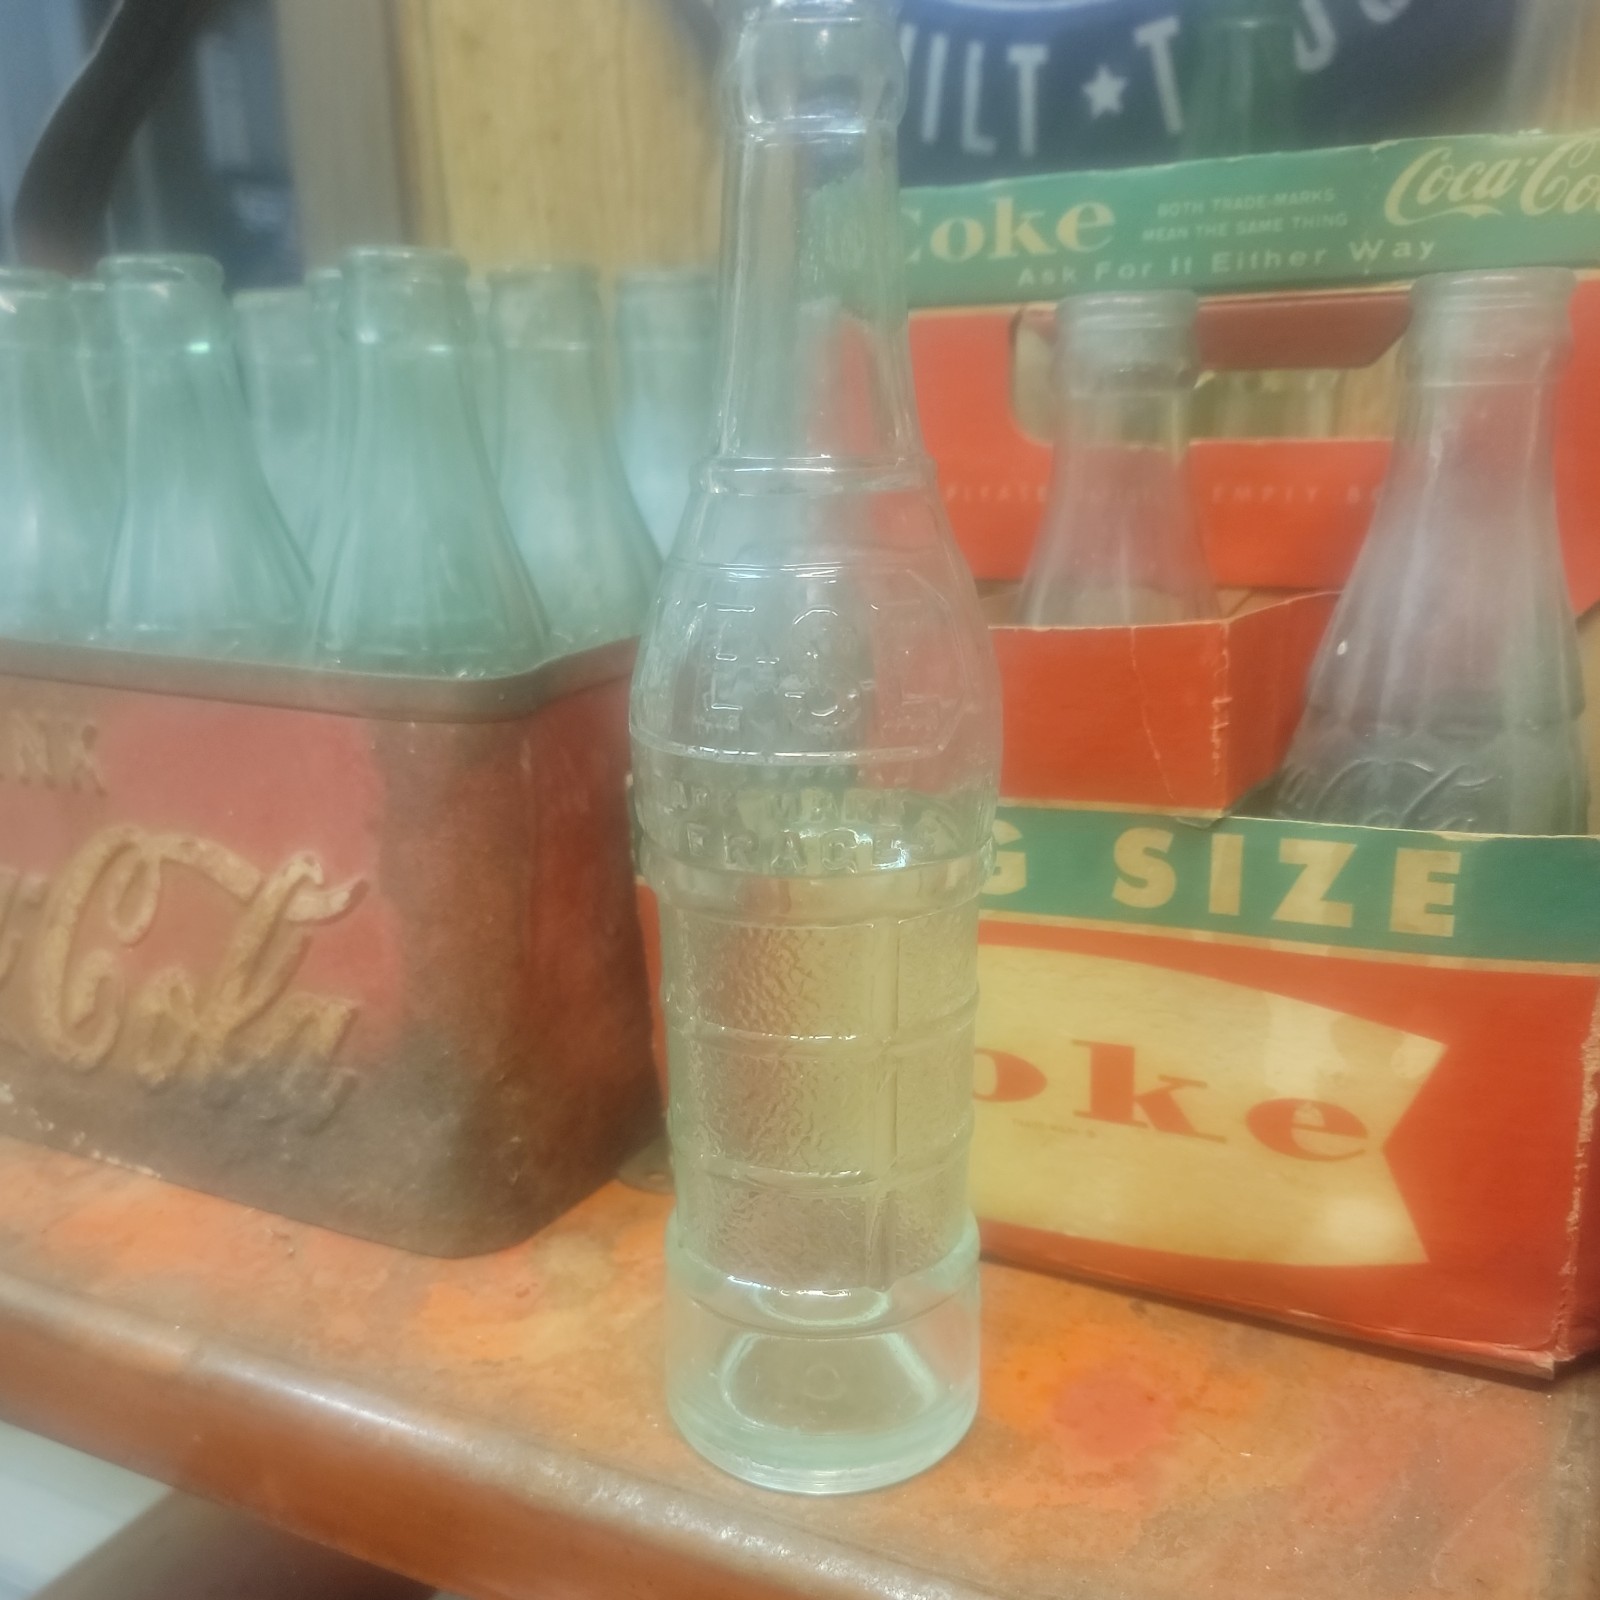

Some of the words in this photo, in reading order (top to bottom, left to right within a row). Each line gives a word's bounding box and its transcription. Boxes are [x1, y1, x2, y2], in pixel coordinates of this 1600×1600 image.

[1384, 137, 1600, 226] Coca-Co
[1196, 221, 1228, 237] THE
[1291, 210, 1348, 230] THING
[1018, 266, 1077, 288] Ask
[1094, 260, 1152, 281] For
[1170, 256, 1192, 276] It
[1211, 247, 1328, 275] Either
[1348, 237, 1436, 263] Way
[1111, 826, 1463, 938] SIZE
